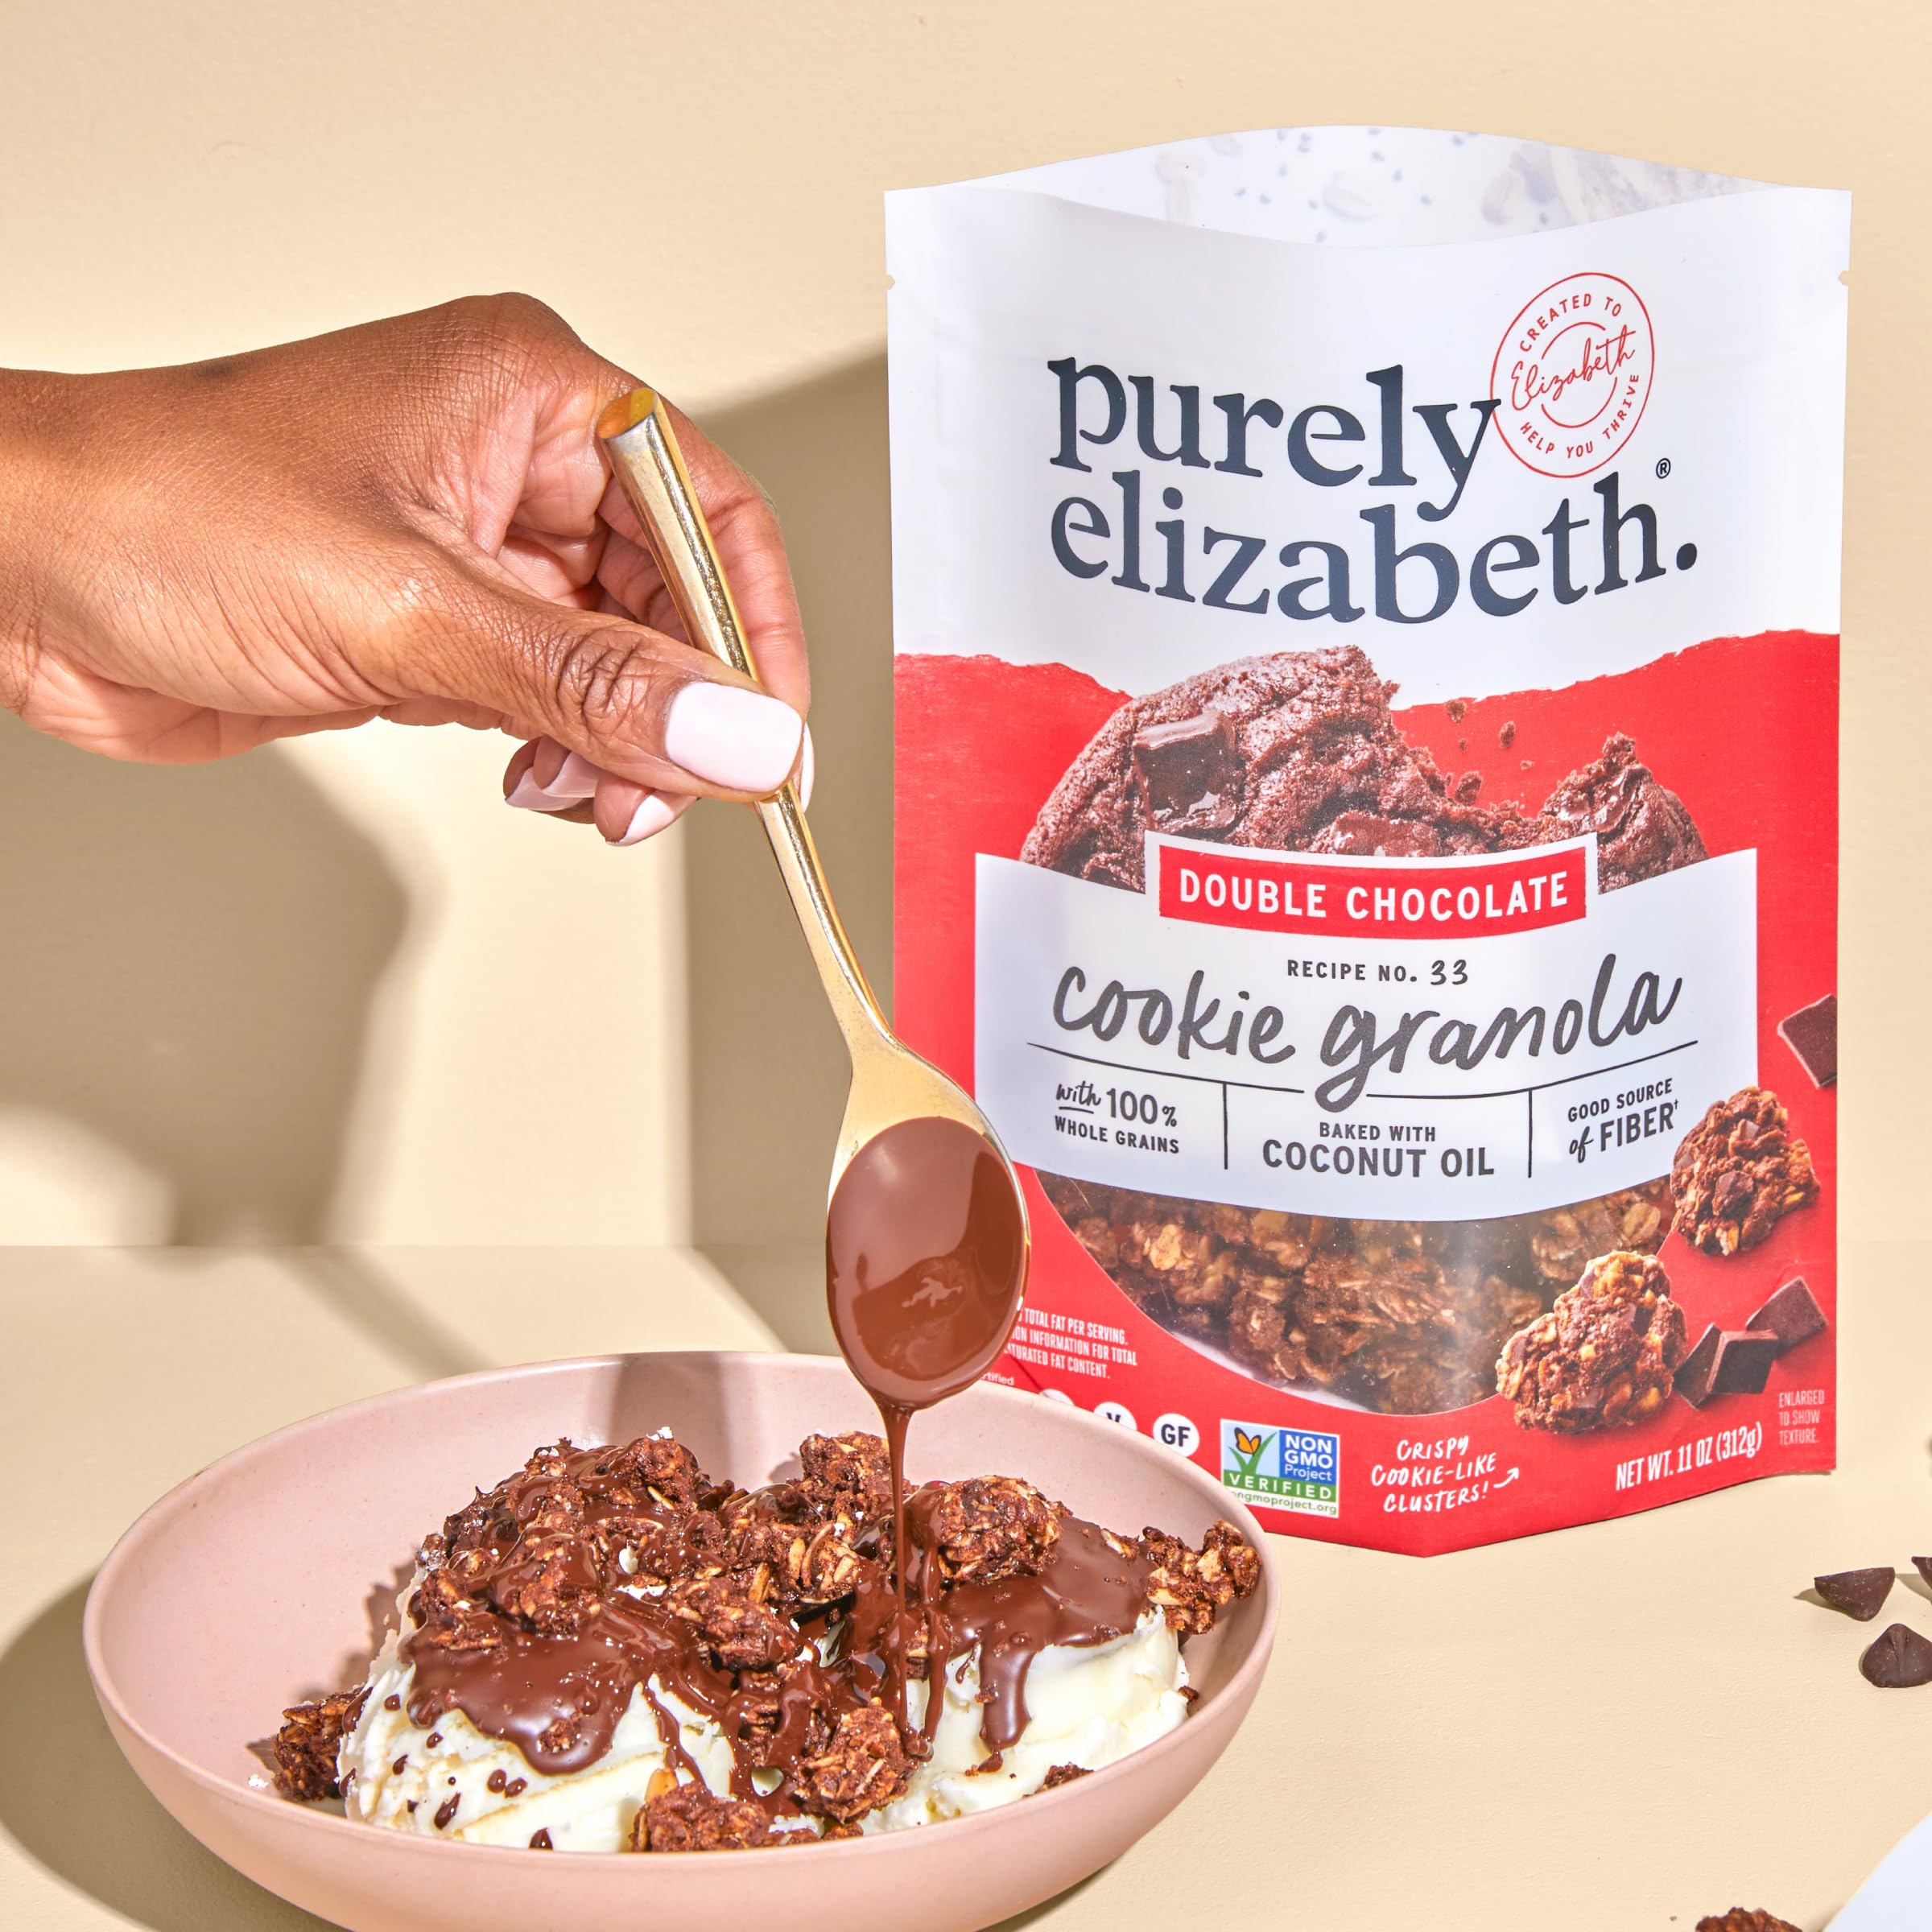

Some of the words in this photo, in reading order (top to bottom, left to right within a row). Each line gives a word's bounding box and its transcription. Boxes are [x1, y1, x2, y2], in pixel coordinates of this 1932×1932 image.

[1520, 293, 1591, 352] CREATED
[1604, 296, 1621, 316] TO
[1511, 324, 1636, 411] Elizabeth
[1520, 422, 1554, 454] HELP
[1567, 441, 1593, 459] YOU
[1602, 374, 1639, 440] THRIVE
[1047, 357, 1501, 522] purely
[1051, 469, 1698, 624] elizabeth.
[1180, 869, 1327, 918] DOUBLE
[1346, 871, 1568, 922] CHOCOLATE
[1287, 959, 1366, 980] RECIPE
[1378, 965, 1418, 982] NO.
[1430, 960, 1468, 985] 33
[1052, 965, 1296, 1059] cookie
[1315, 952, 1683, 1113] granola
[1055, 1080, 1101, 1106] with
[1106, 1088, 1178, 1128] 100%
[1567, 1098, 1610, 1122] GOOD
[1616, 1077, 1673, 1109] SOURCE
[1055, 1115, 1108, 1142] WHOLE
[1115, 1130, 1179, 1154] GRAINS
[1319, 1121, 1381, 1141] BAKED
[1389, 1125, 1436, 1142] WITH
[1569, 1125, 1594, 1163] of
[1262, 1139, 1426, 1178] COCONUT
[1440, 1146, 1495, 1178] OIL
[1024, 1307, 1050, 1327] TOTAL
[1051, 1314, 1066, 1331] FAT
[1067, 1318, 1084, 1335] PER
[1087, 1323, 1129, 1345] SERVING.
[1004, 1343, 1048, 1366] ATURATED
[1051, 1352, 1066, 1371] FAT
[1067, 1357, 1111, 1379] CONTENT.
[1030, 1329, 1088, 1357] INFORMATION
[1092, 1343, 1109, 1360] FOR
[1111, 1346, 1137, 1366] TOTAL
[981, 1372, 1014, 1385] rtified
[1778, 1389, 1825, 1408] ENLARGED
[1160, 1423, 1191, 1447] GF
[1778, 1411, 1790, 1426] TO
[1792, 1410, 1820, 1425] SHOW
[1285, 1435, 1331, 1453] NON
[1778, 1428, 1819, 1446] TEXTURE.
[1284, 1450, 1333, 1469] GMO
[1284, 1463, 1332, 1481] Project
[1371, 1452, 1496, 1487] COOKIE-LIKE
[1616, 1457, 1645, 1491] NET
[1648, 1450, 1674, 1482] WT.
[1677, 1443, 1692, 1473] 11
[1695, 1436, 1713, 1468] OZ
[1715, 1421, 1763, 1462] (312g)
[1228, 1472, 1331, 1500] VERIFIED
[1232, 1491, 1337, 1516] ngmoproject.org
[1383, 1480, 1488, 1513] CLUSTERS!
